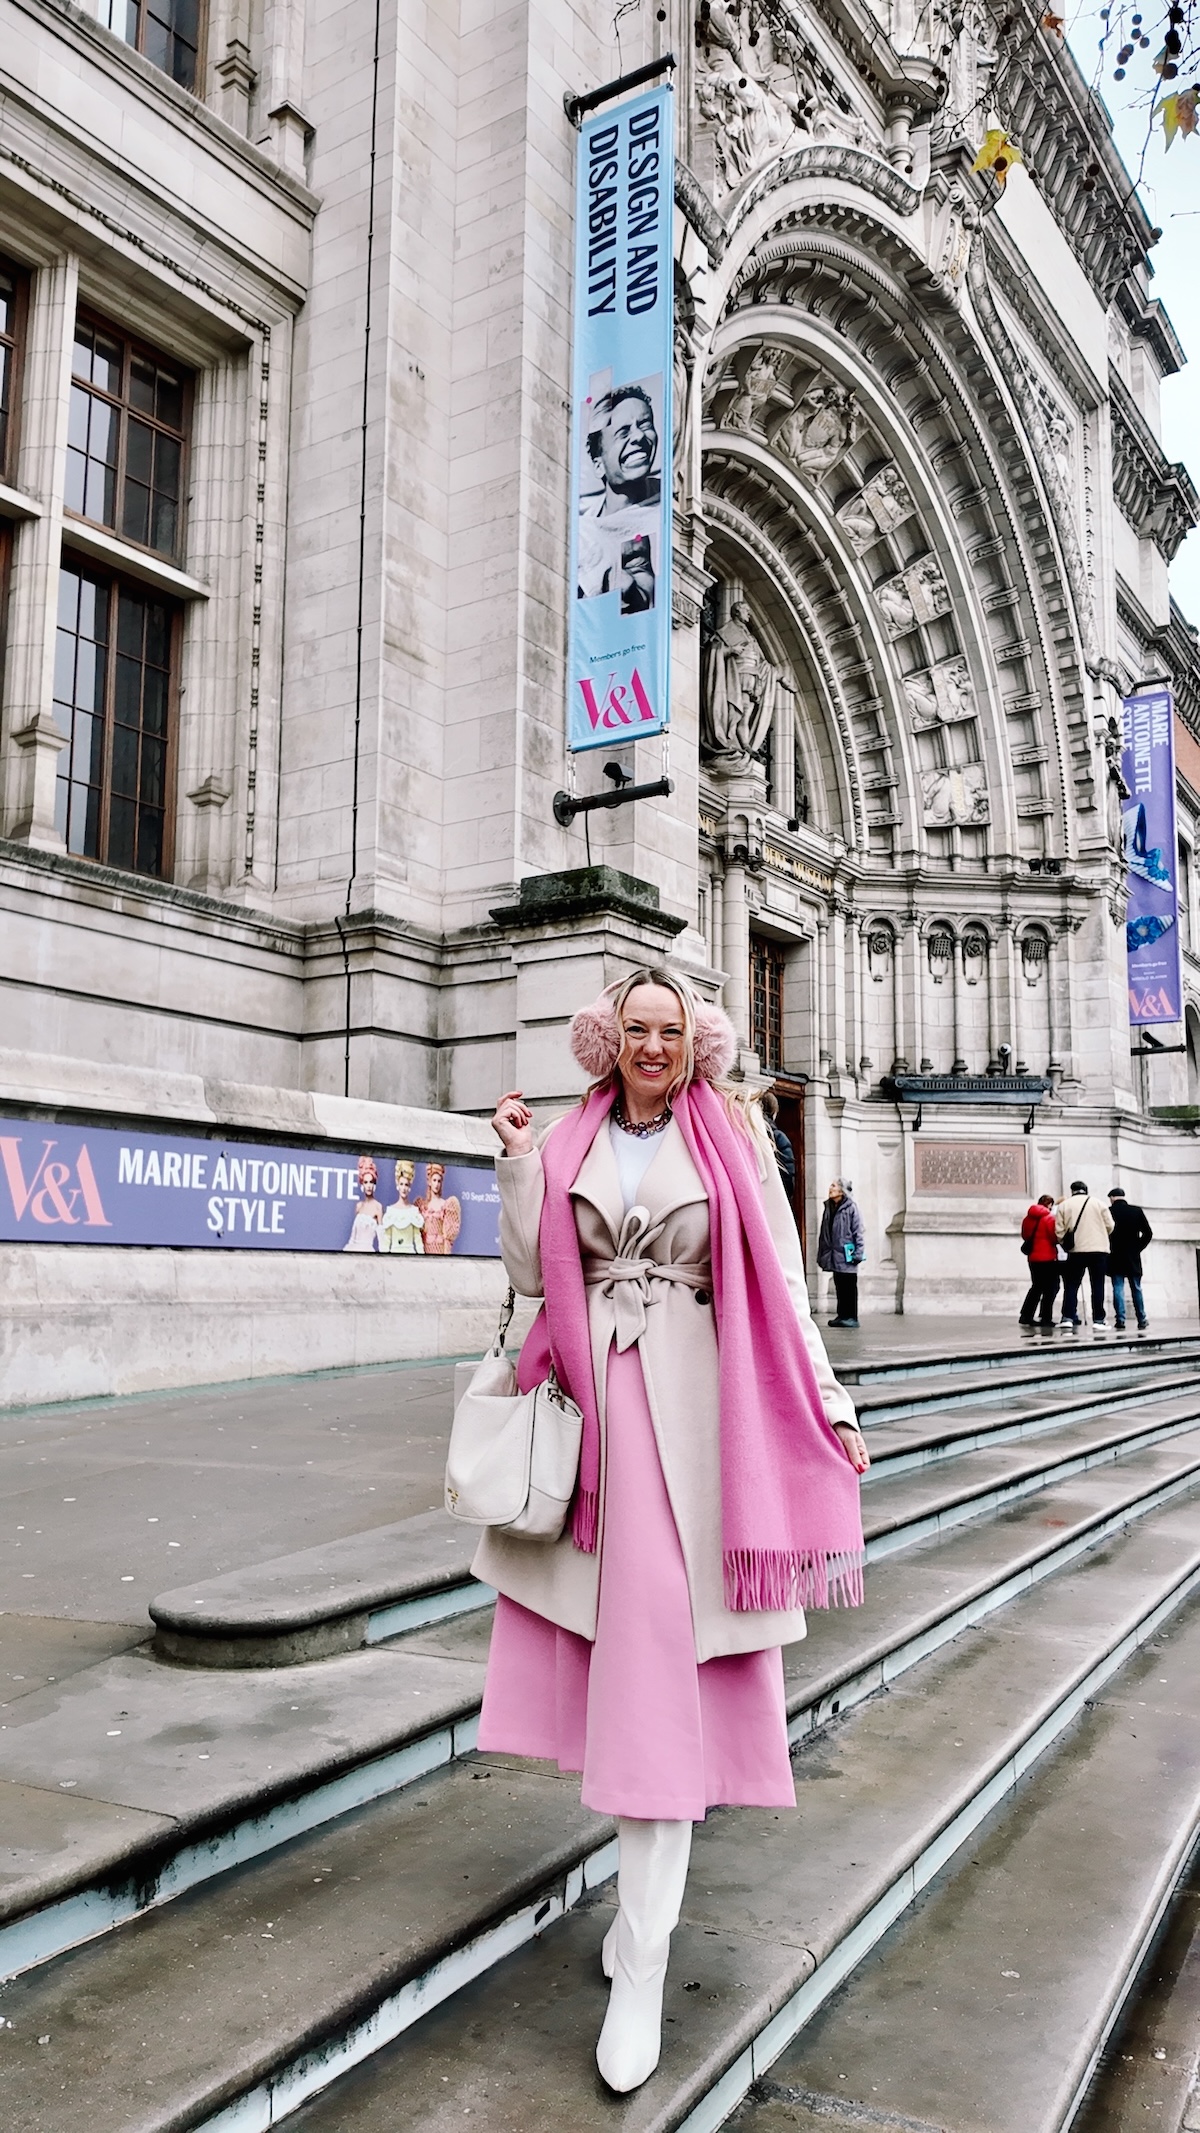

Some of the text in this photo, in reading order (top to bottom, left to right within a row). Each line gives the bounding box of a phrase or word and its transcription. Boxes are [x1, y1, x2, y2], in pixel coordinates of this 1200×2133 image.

[588, 124, 619, 317] DISABILITY
[626, 105, 660, 316] DESIGN AND
[590, 651, 621, 663] Members
[623, 649, 630, 657] go
[576, 667, 659, 731] V&A
[1152, 700, 1169, 748] MARIE
[1134, 704, 1152, 795] ANTOINETTE
[793, 859, 832, 893] MUSEUM
[1128, 987, 1176, 1018] V&A
[0, 1136, 113, 1226] V&A
[118, 1147, 360, 1200] MARIE ANTOINETTE
[462, 1191, 470, 1200] 20
[471, 1191, 484, 1203] Sept
[207, 1196, 286, 1234] STYLE
